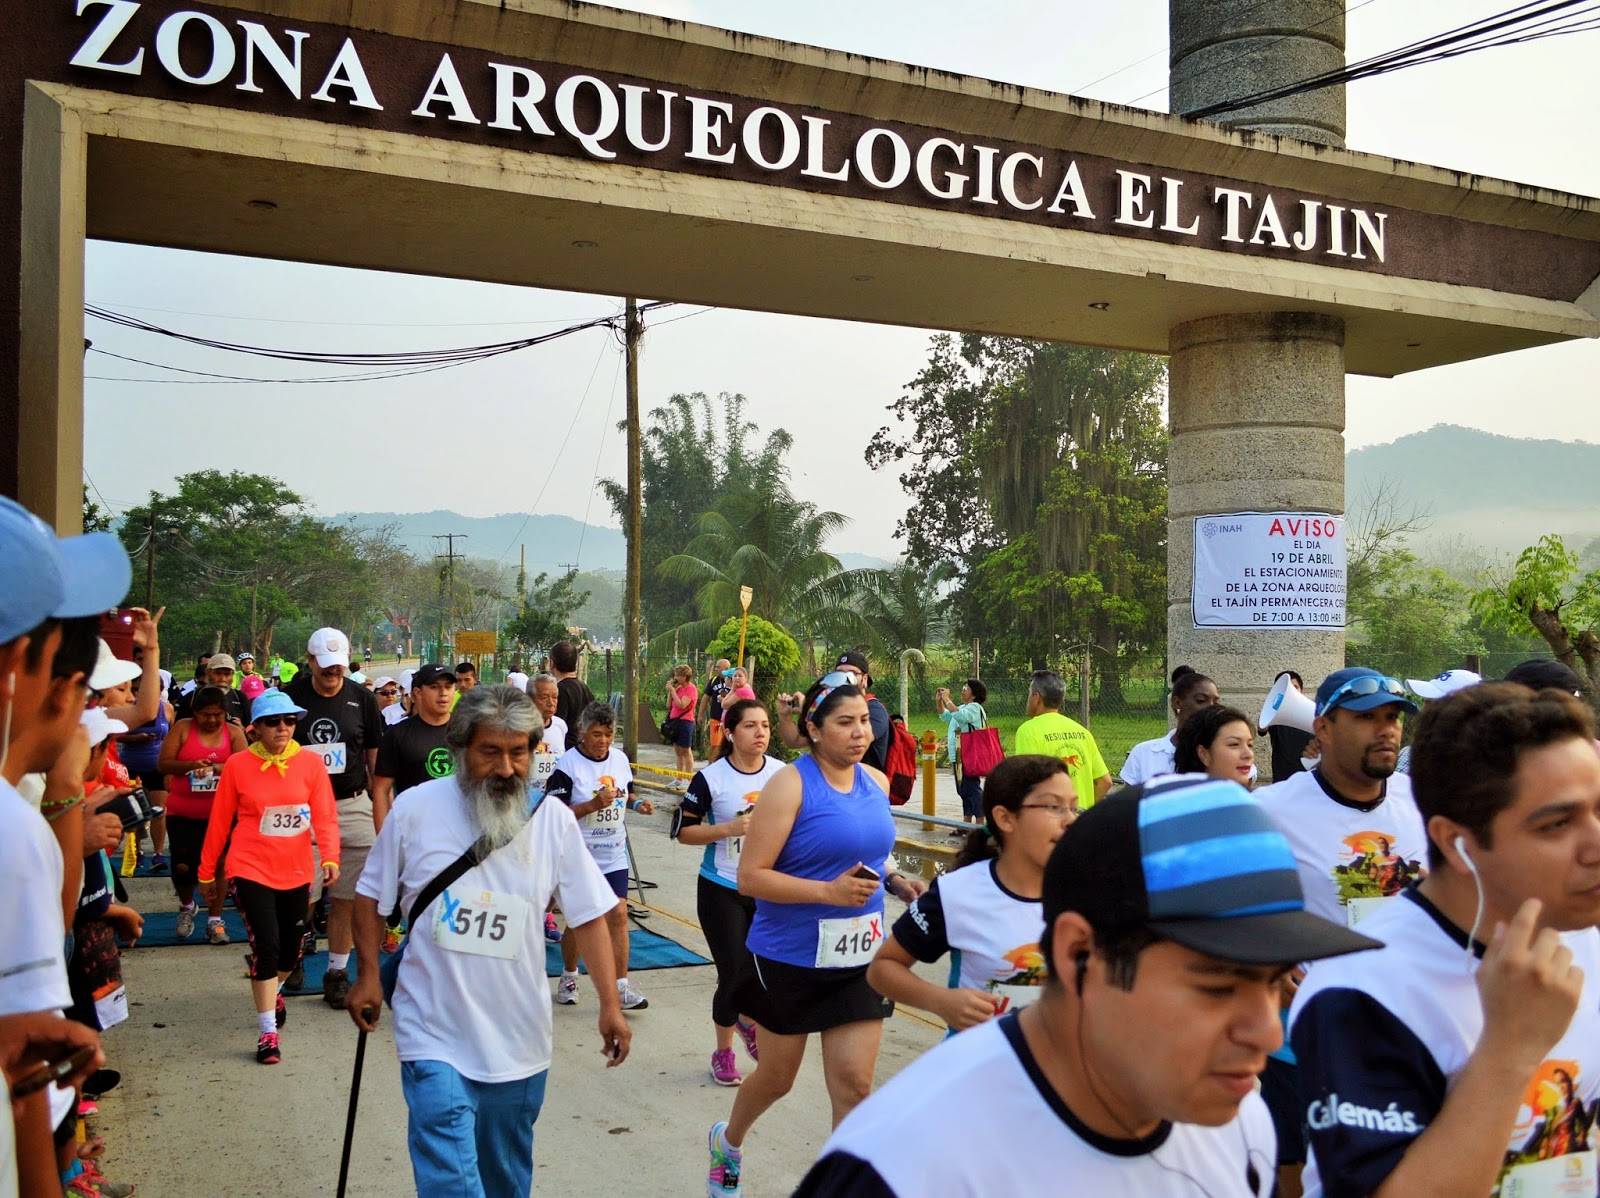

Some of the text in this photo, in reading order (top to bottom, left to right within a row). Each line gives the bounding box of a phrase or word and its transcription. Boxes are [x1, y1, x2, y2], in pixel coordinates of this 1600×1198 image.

[70, 0, 1389, 263] ZONA ARQUEOLOGICA EL TAJIN
[1219, 524, 1242, 533] INAH
[1268, 518, 1336, 538] AVISO
[1294, 540, 1321, 550] EL DIA
[1271, 552, 1334, 564] 19 DE ABRIL
[1244, 568, 1344, 579] EL ESTACIONAMIENTO
[1226, 583, 1240, 592] DE
[1244, 582, 1258, 592] LA
[1262, 582, 1294, 592] ZONA
[1212, 598, 1222, 608] EL
[1226, 595, 1257, 608] TAJÍN
[1261, 598, 1334, 608] PERMANECERA
[1253, 612, 1267, 622] DE
[1272, 612, 1294, 622] 7:00
[1297, 612, 1305, 622] A
[1308, 613, 1330, 622] 13:00
[1044, 732, 1086, 742] RESULTADOS
[272, 814, 302, 828] 332
[596, 808, 620, 822] 583
[455, 908, 508, 942] 515
[834, 930, 872, 956] 416
